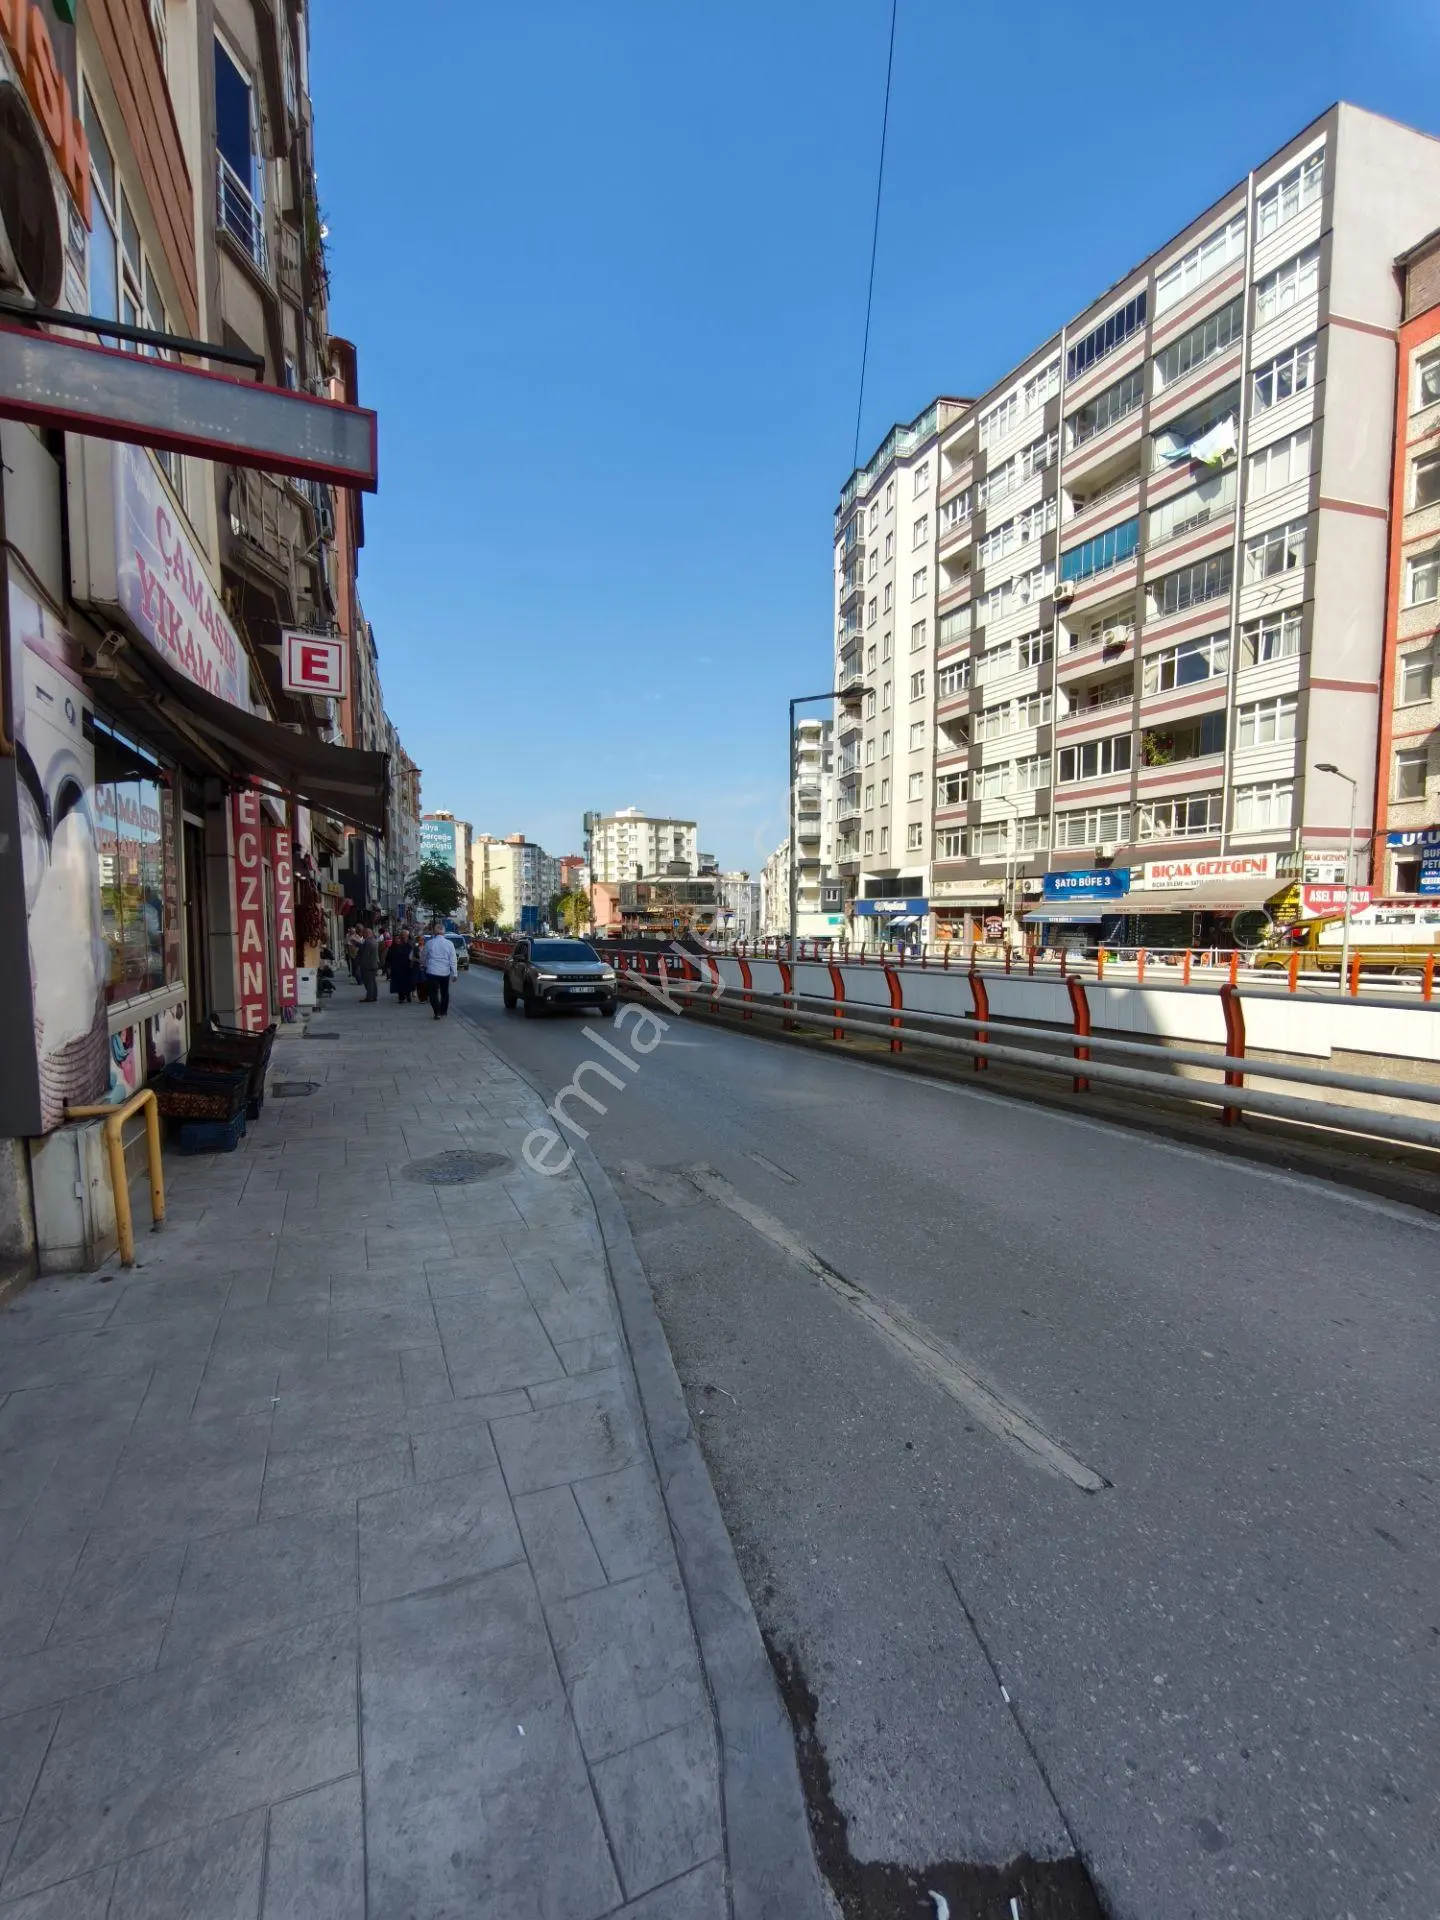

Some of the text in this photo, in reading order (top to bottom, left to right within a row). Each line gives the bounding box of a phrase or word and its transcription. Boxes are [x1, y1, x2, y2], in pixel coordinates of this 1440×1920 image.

[133, 547, 221, 697] YIKAMA
[156, 505, 237, 680] ÇAMAŞIR
[302, 646, 330, 684] E
[238, 789, 264, 1034] ECZANE
[1055, 876, 1111, 889] ŞATO BÜFE 3
[1152, 855, 1267, 880] BIÇAK GEZEGENİ
[1309, 889, 1369, 903] ASEL MOİLYA
[276, 832, 295, 998] ECZANE
